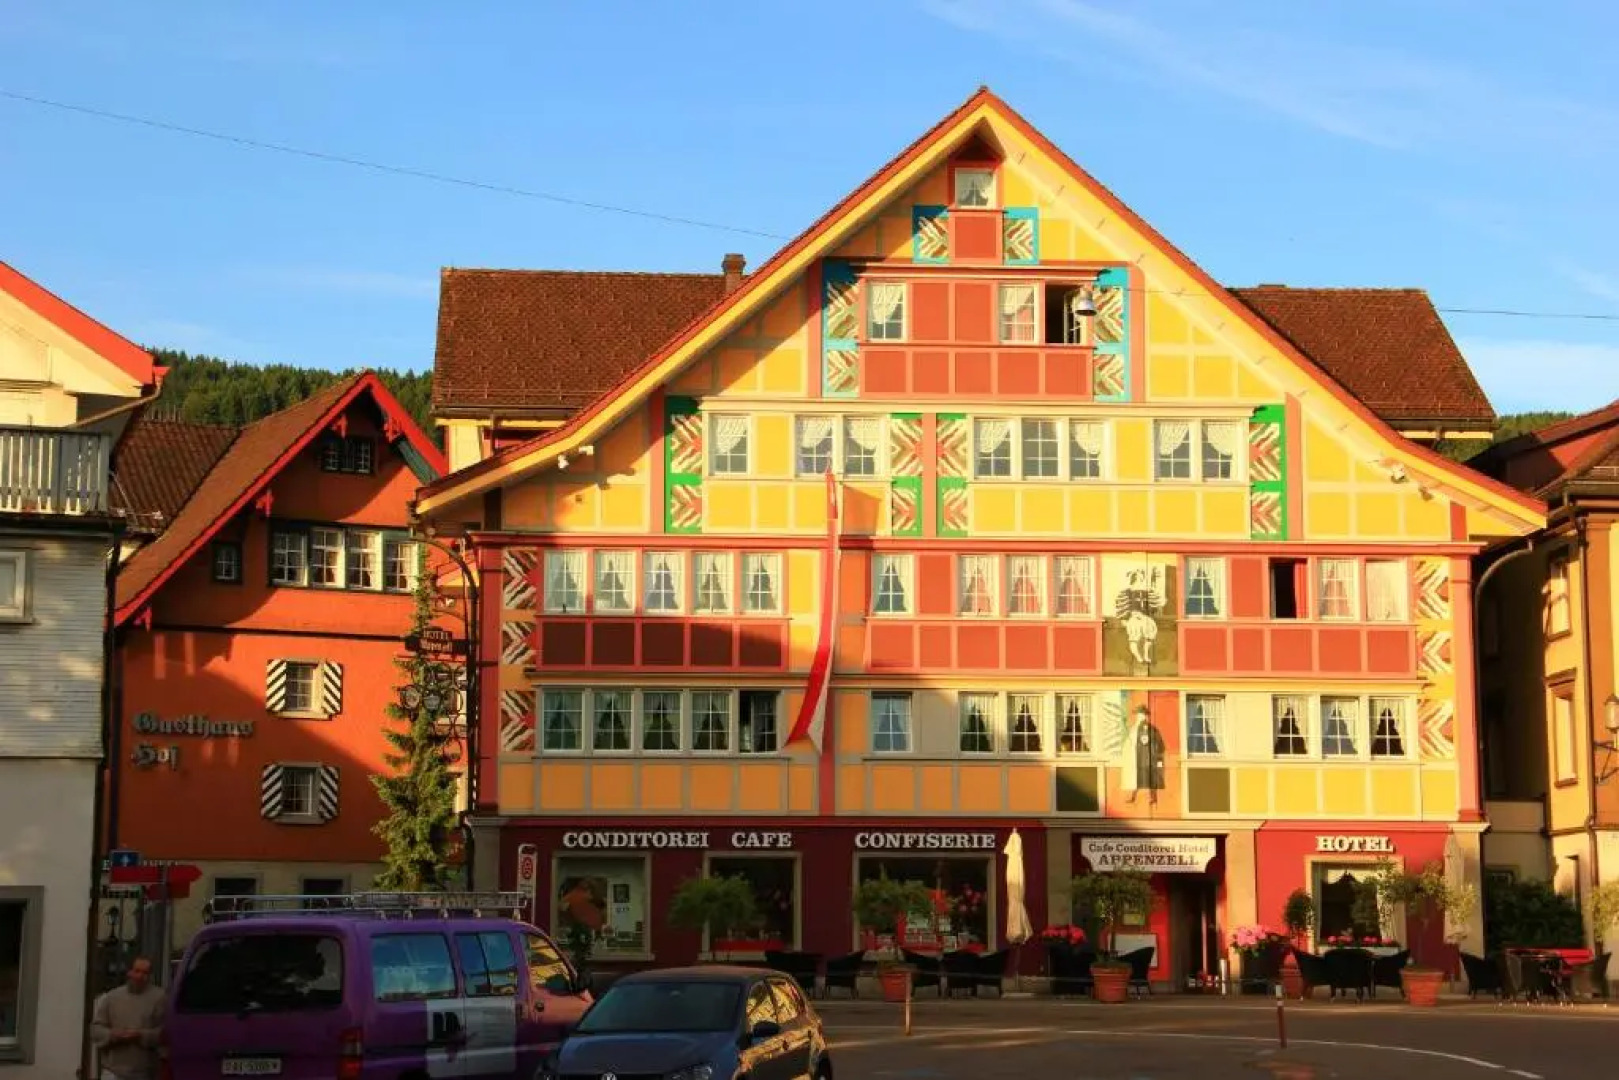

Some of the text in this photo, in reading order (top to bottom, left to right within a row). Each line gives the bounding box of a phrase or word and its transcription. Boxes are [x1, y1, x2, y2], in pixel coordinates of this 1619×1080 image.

[562, 832, 792, 848] CONDITOREI CAFE
[855, 832, 996, 849] CONFISERIE
[1316, 836, 1394, 852] HOTEL
[1099, 855, 1199, 866] APPENZELL
